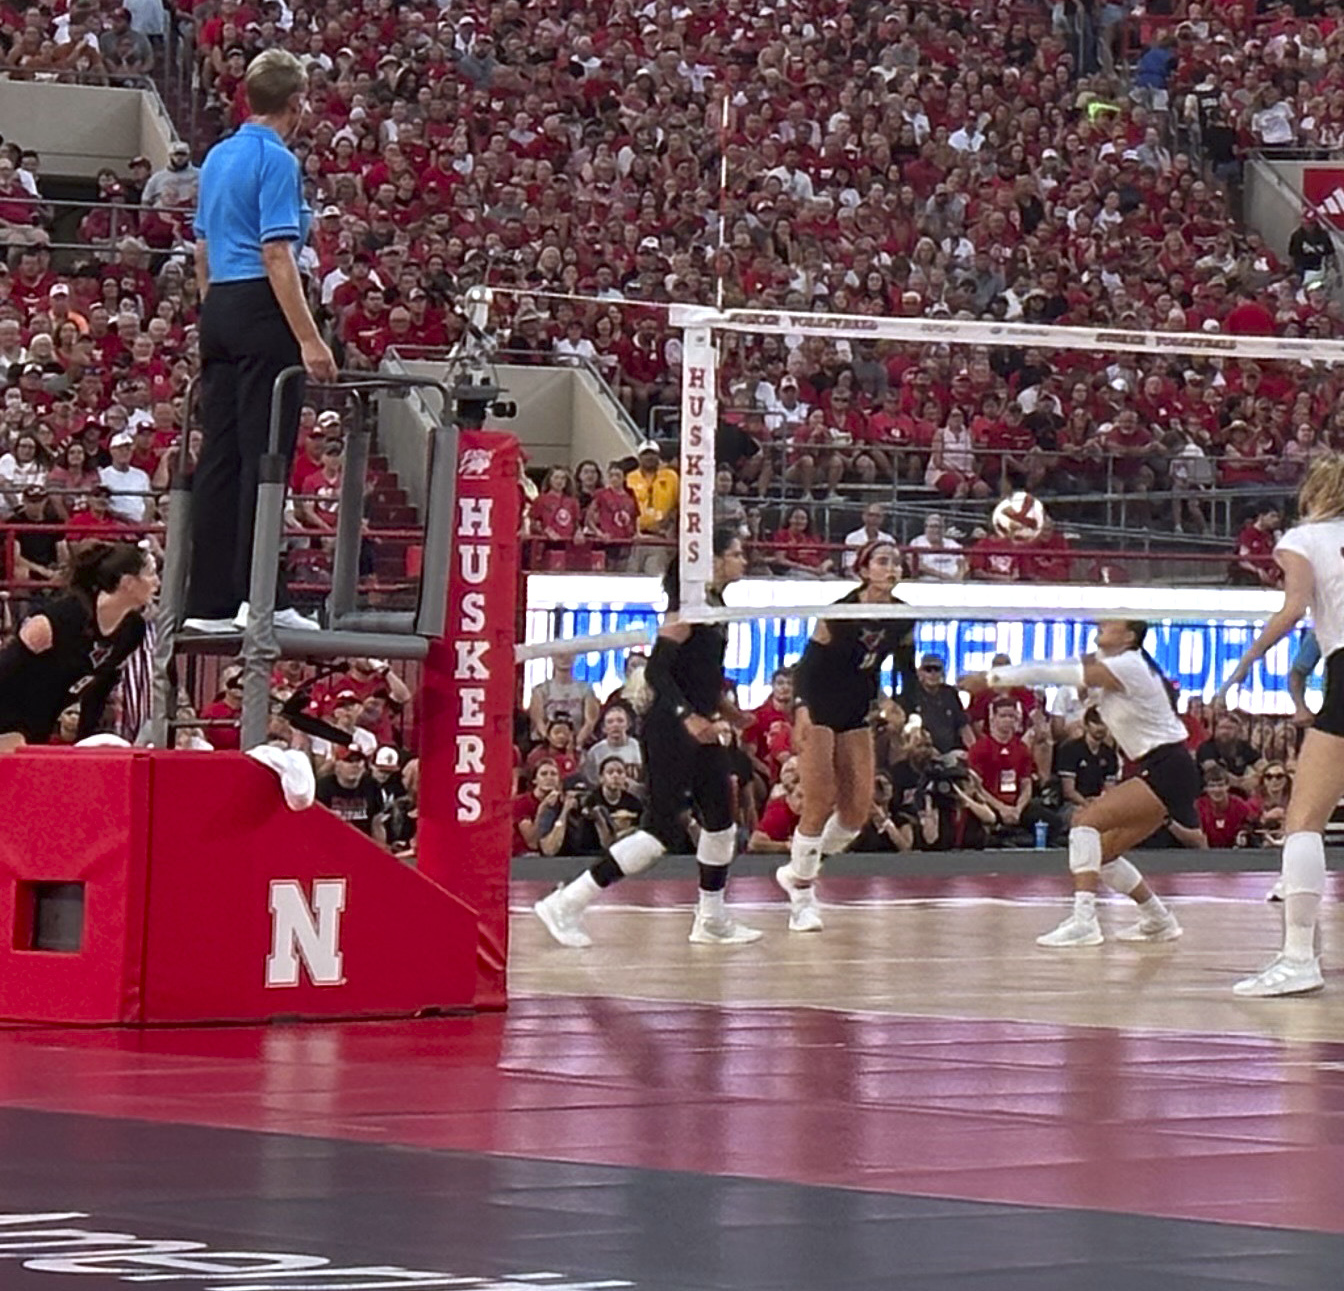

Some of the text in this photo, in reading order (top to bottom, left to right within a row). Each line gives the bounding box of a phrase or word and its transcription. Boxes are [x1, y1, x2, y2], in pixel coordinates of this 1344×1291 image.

[686, 367, 706, 564] HUSKERS
[454, 497, 495, 823] HUSKERS
[265, 877, 346, 988] N
